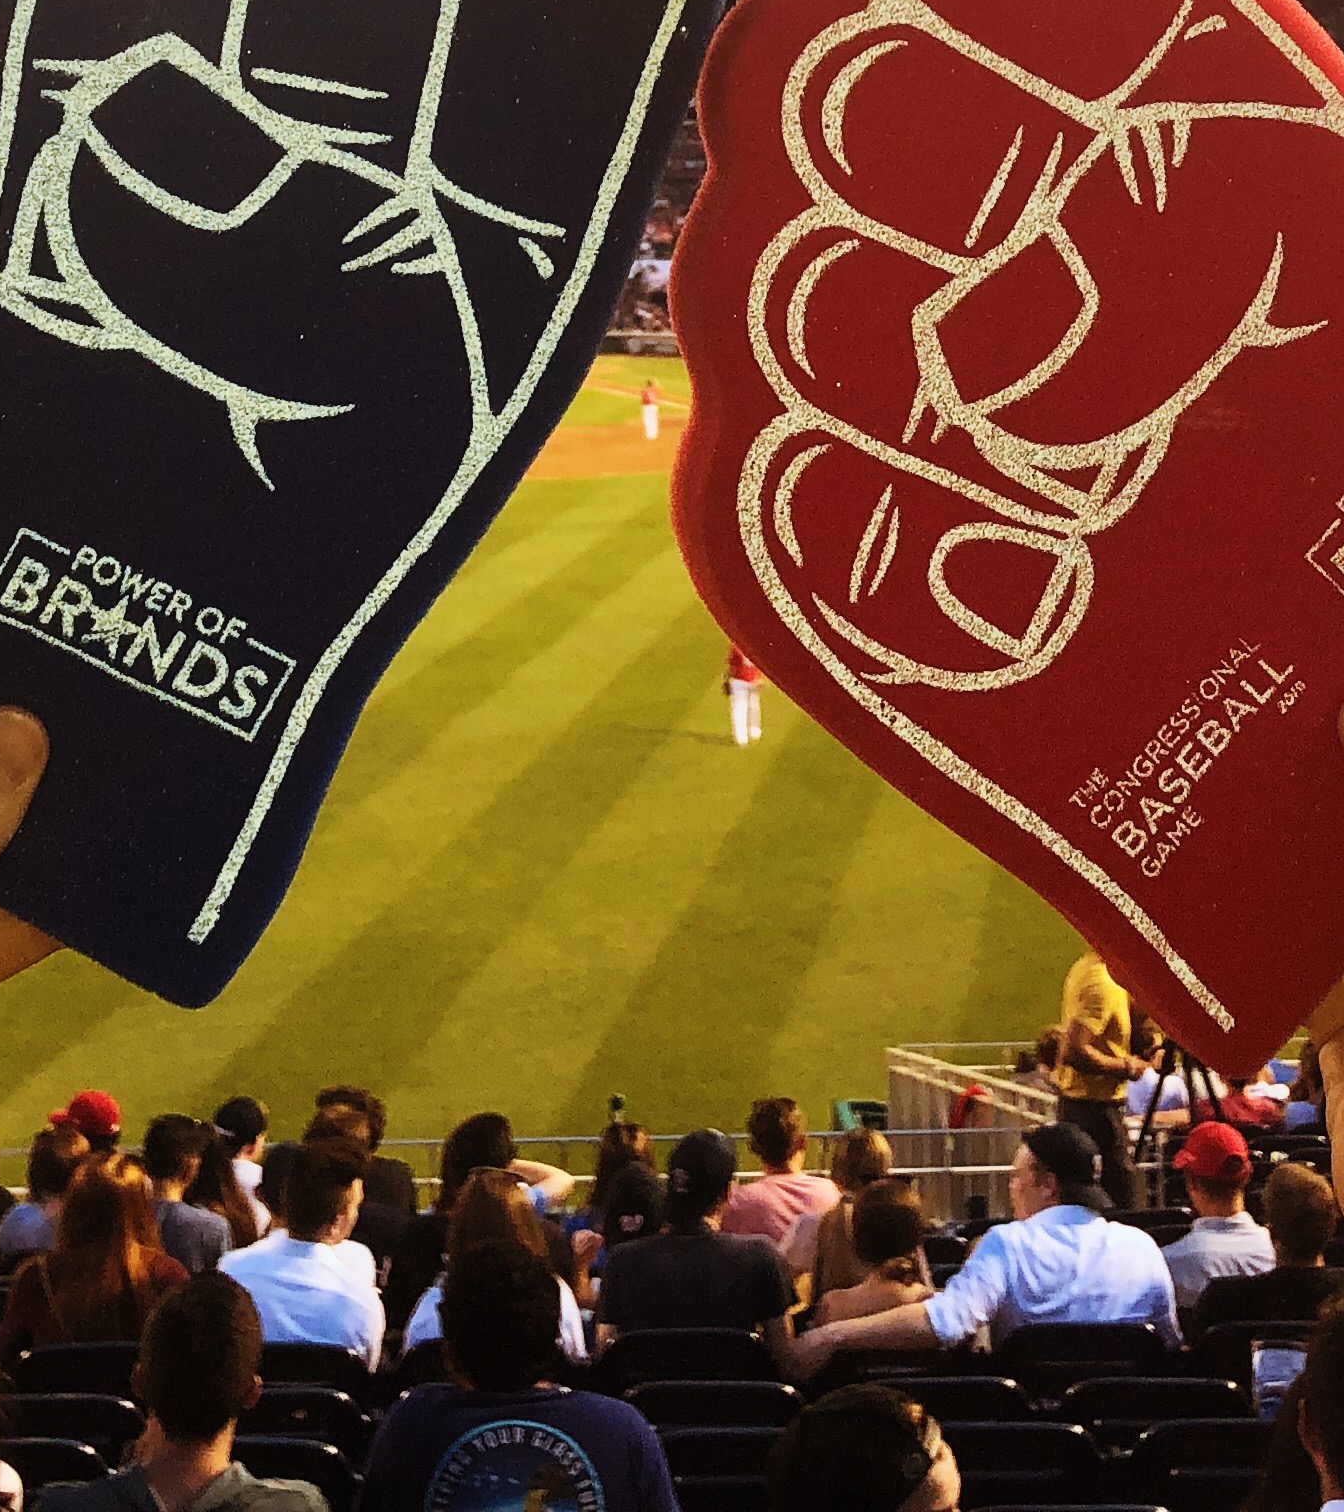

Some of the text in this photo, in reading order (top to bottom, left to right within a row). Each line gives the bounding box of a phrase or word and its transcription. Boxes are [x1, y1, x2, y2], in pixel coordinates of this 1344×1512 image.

[71, 544, 247, 644] POWER OF
[1090, 637, 1261, 830] CONGRESSIONAL
[1112, 659, 1294, 858] BASEBALL
[1068, 767, 1110, 808] THE
[1141, 805, 1203, 878] GAME
